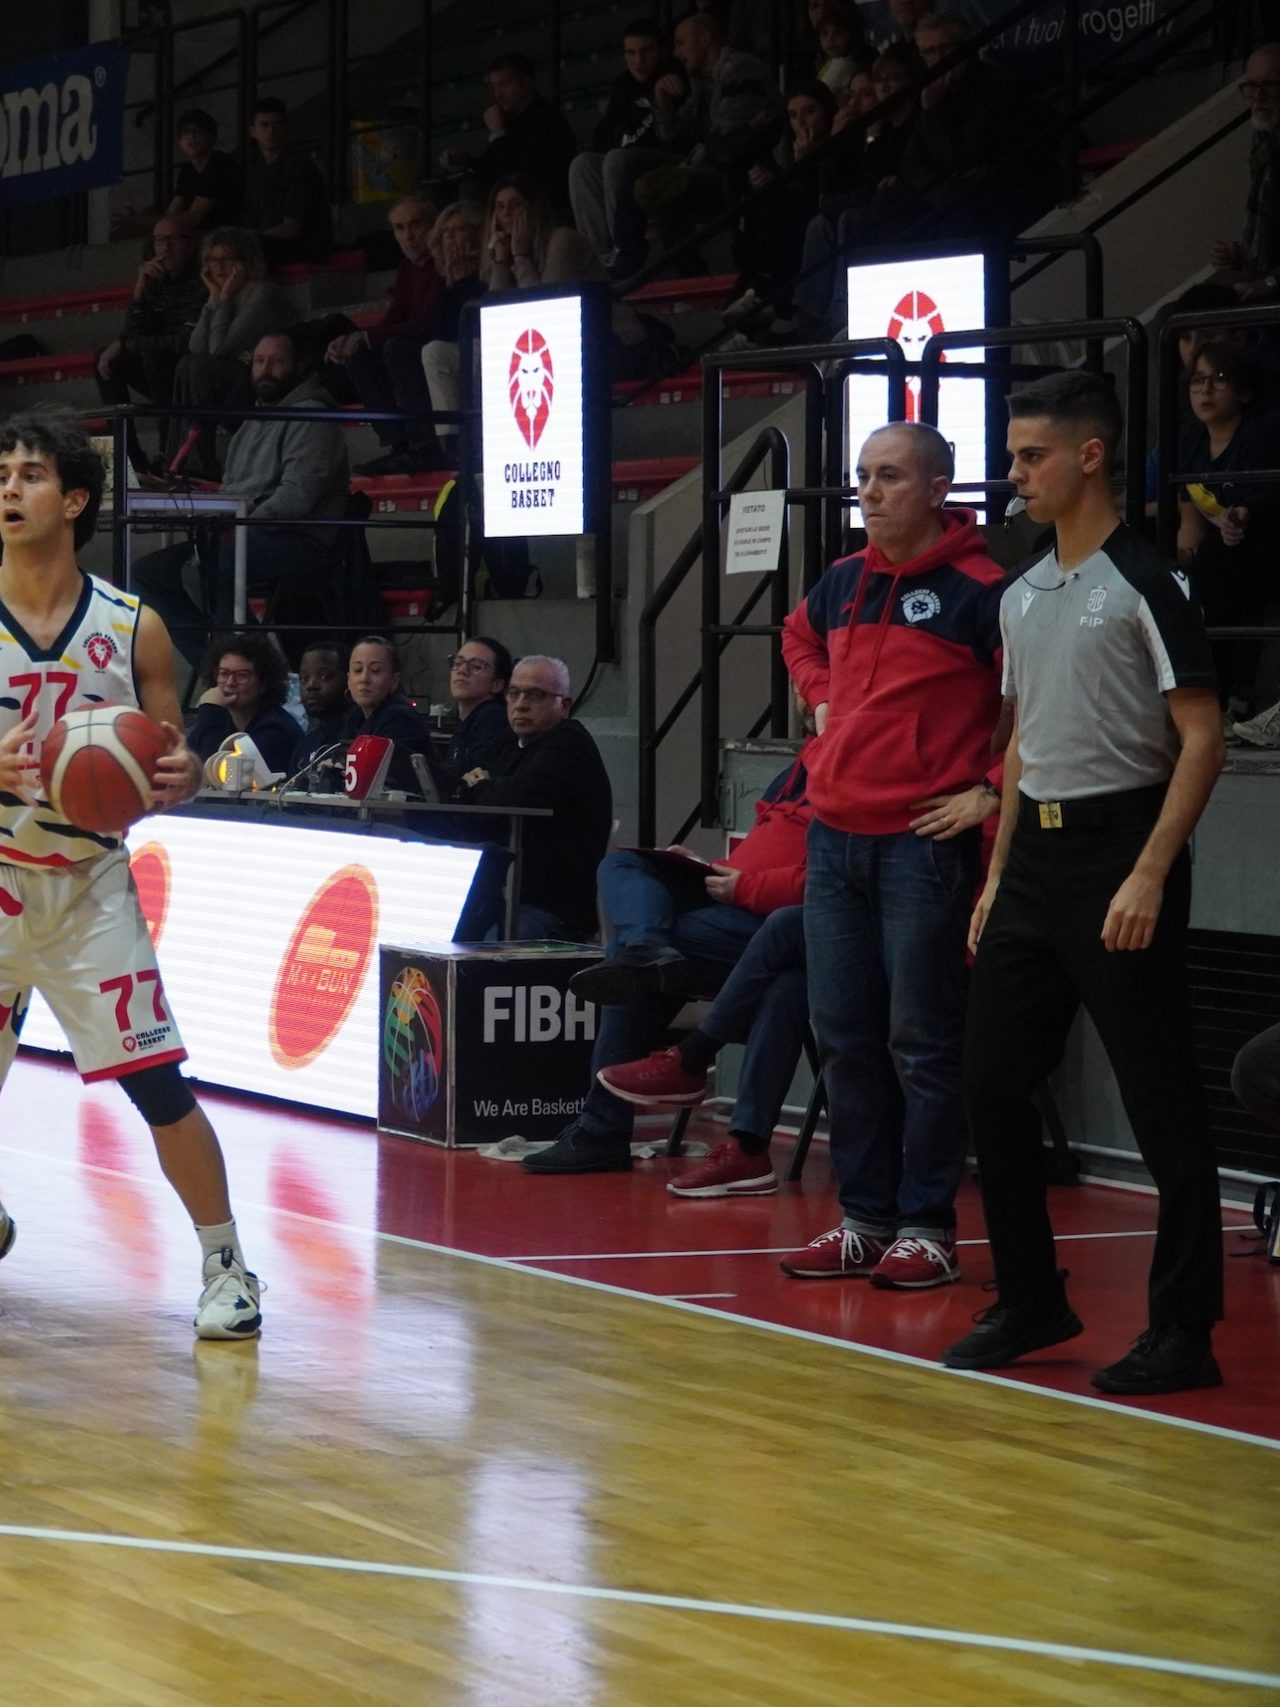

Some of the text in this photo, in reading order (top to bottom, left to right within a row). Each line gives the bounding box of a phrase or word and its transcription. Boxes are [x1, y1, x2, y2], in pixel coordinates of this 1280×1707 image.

[1078, 0, 1156, 43] rogetti
[504, 460, 561, 483] COLLEGNO
[511, 488, 555, 509] BASKET
[1079, 616, 1104, 628] FIP
[8, 671, 78, 725] 77
[345, 753, 358, 792] 5
[99, 968, 168, 1033] 77
[473, 1099, 499, 1117] We
[501, 1099, 529, 1116] Are
